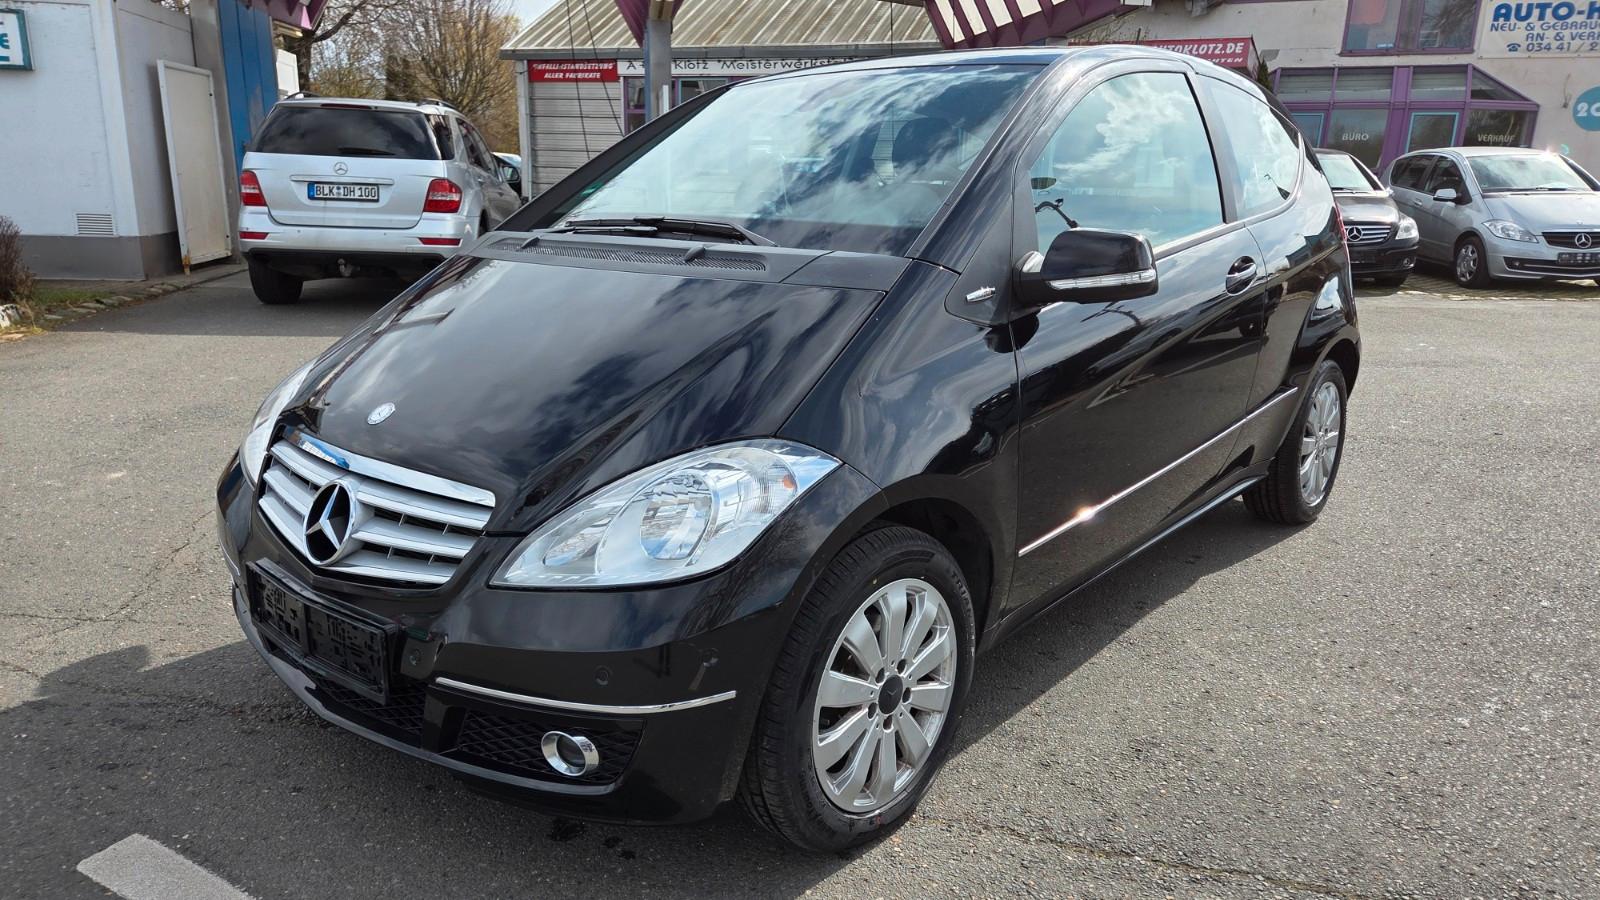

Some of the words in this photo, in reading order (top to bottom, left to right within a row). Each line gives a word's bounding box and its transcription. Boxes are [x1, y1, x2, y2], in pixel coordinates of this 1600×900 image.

[1525, 22, 1536, 31] &
[1554, 31, 1565, 41] &
[675, 60, 709, 70] Klotz
[316, 186, 334, 197] BLK
[343, 187, 355, 197] DH
[358, 187, 377, 198] 100
